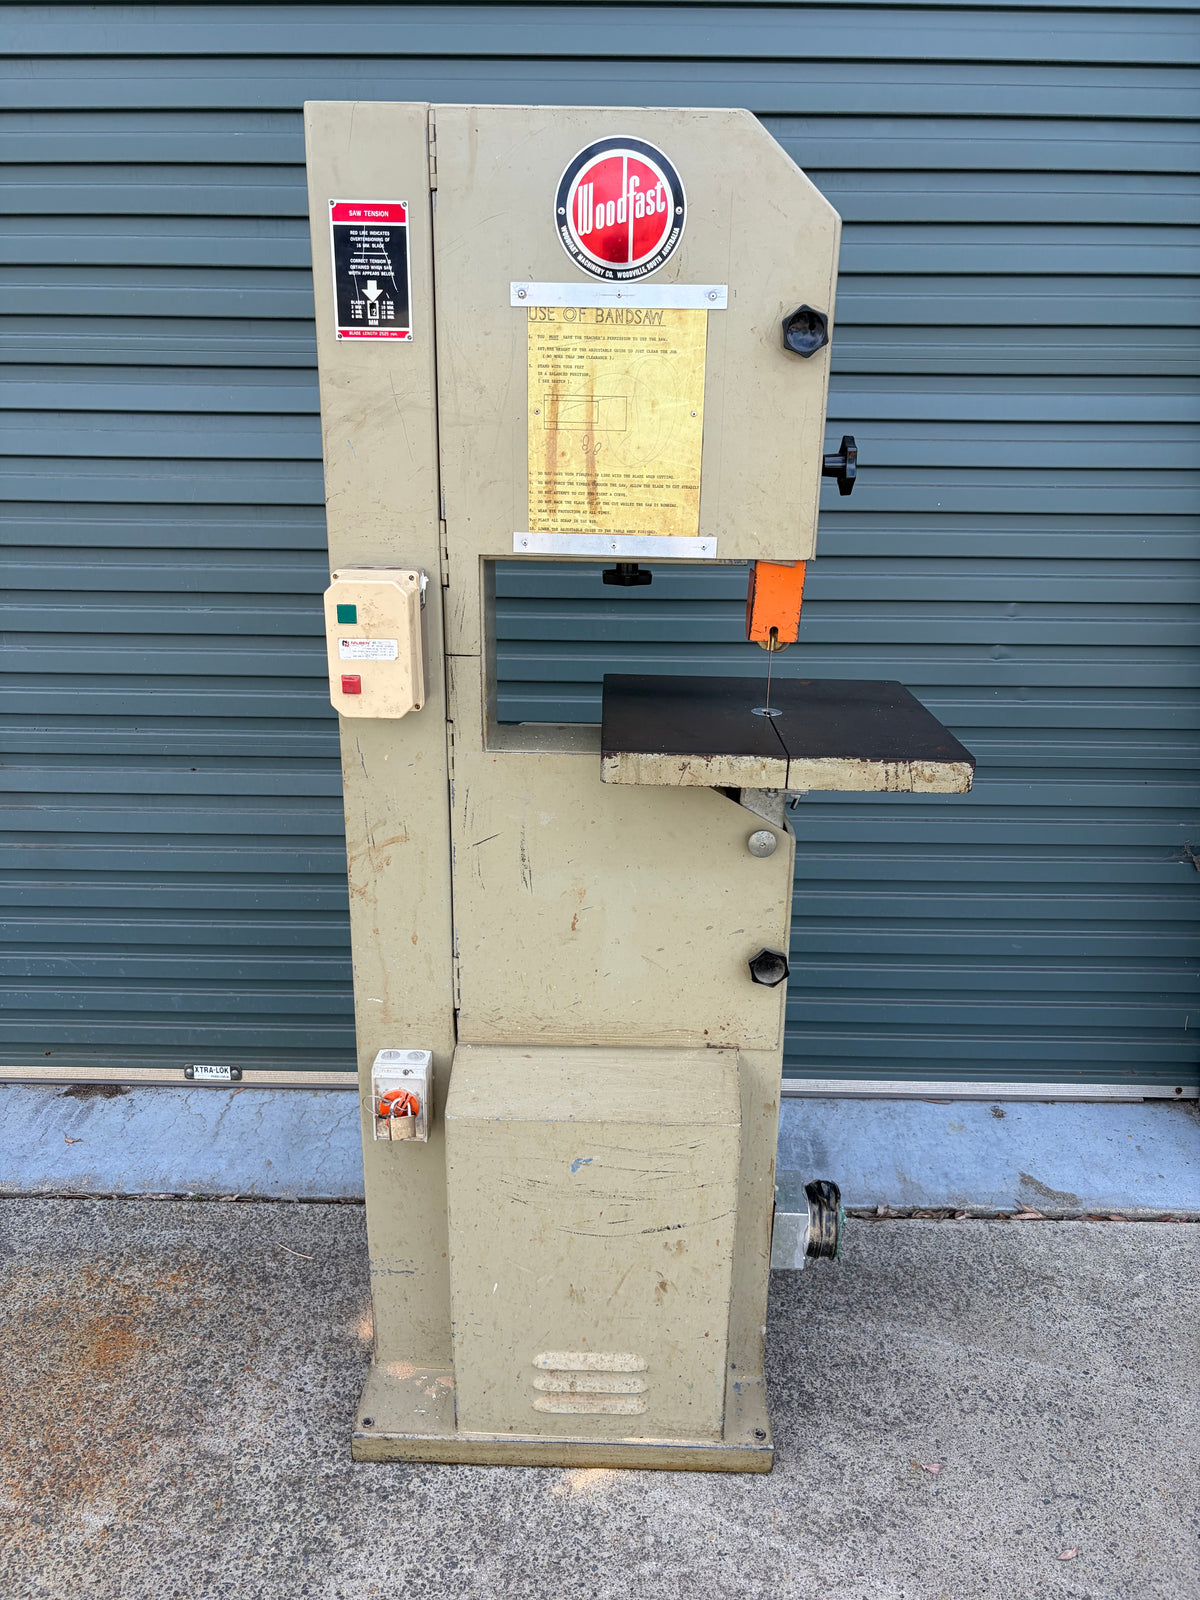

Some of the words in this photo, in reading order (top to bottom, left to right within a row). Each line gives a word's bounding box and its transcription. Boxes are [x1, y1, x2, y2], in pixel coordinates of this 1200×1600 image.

[578, 163, 666, 257] Woodfast
[560, 225, 577, 254] WOODFAST
[577, 253, 604, 275] MACHINERY
[617, 266, 647, 278] WOODVILLE,
[646, 256, 662, 272] SOUTH
[662, 227, 680, 256] AUSTRALIA
[529, 307, 555, 320] USE
[563, 307, 586, 322] OF
[595, 308, 664, 324] BANDSAW
